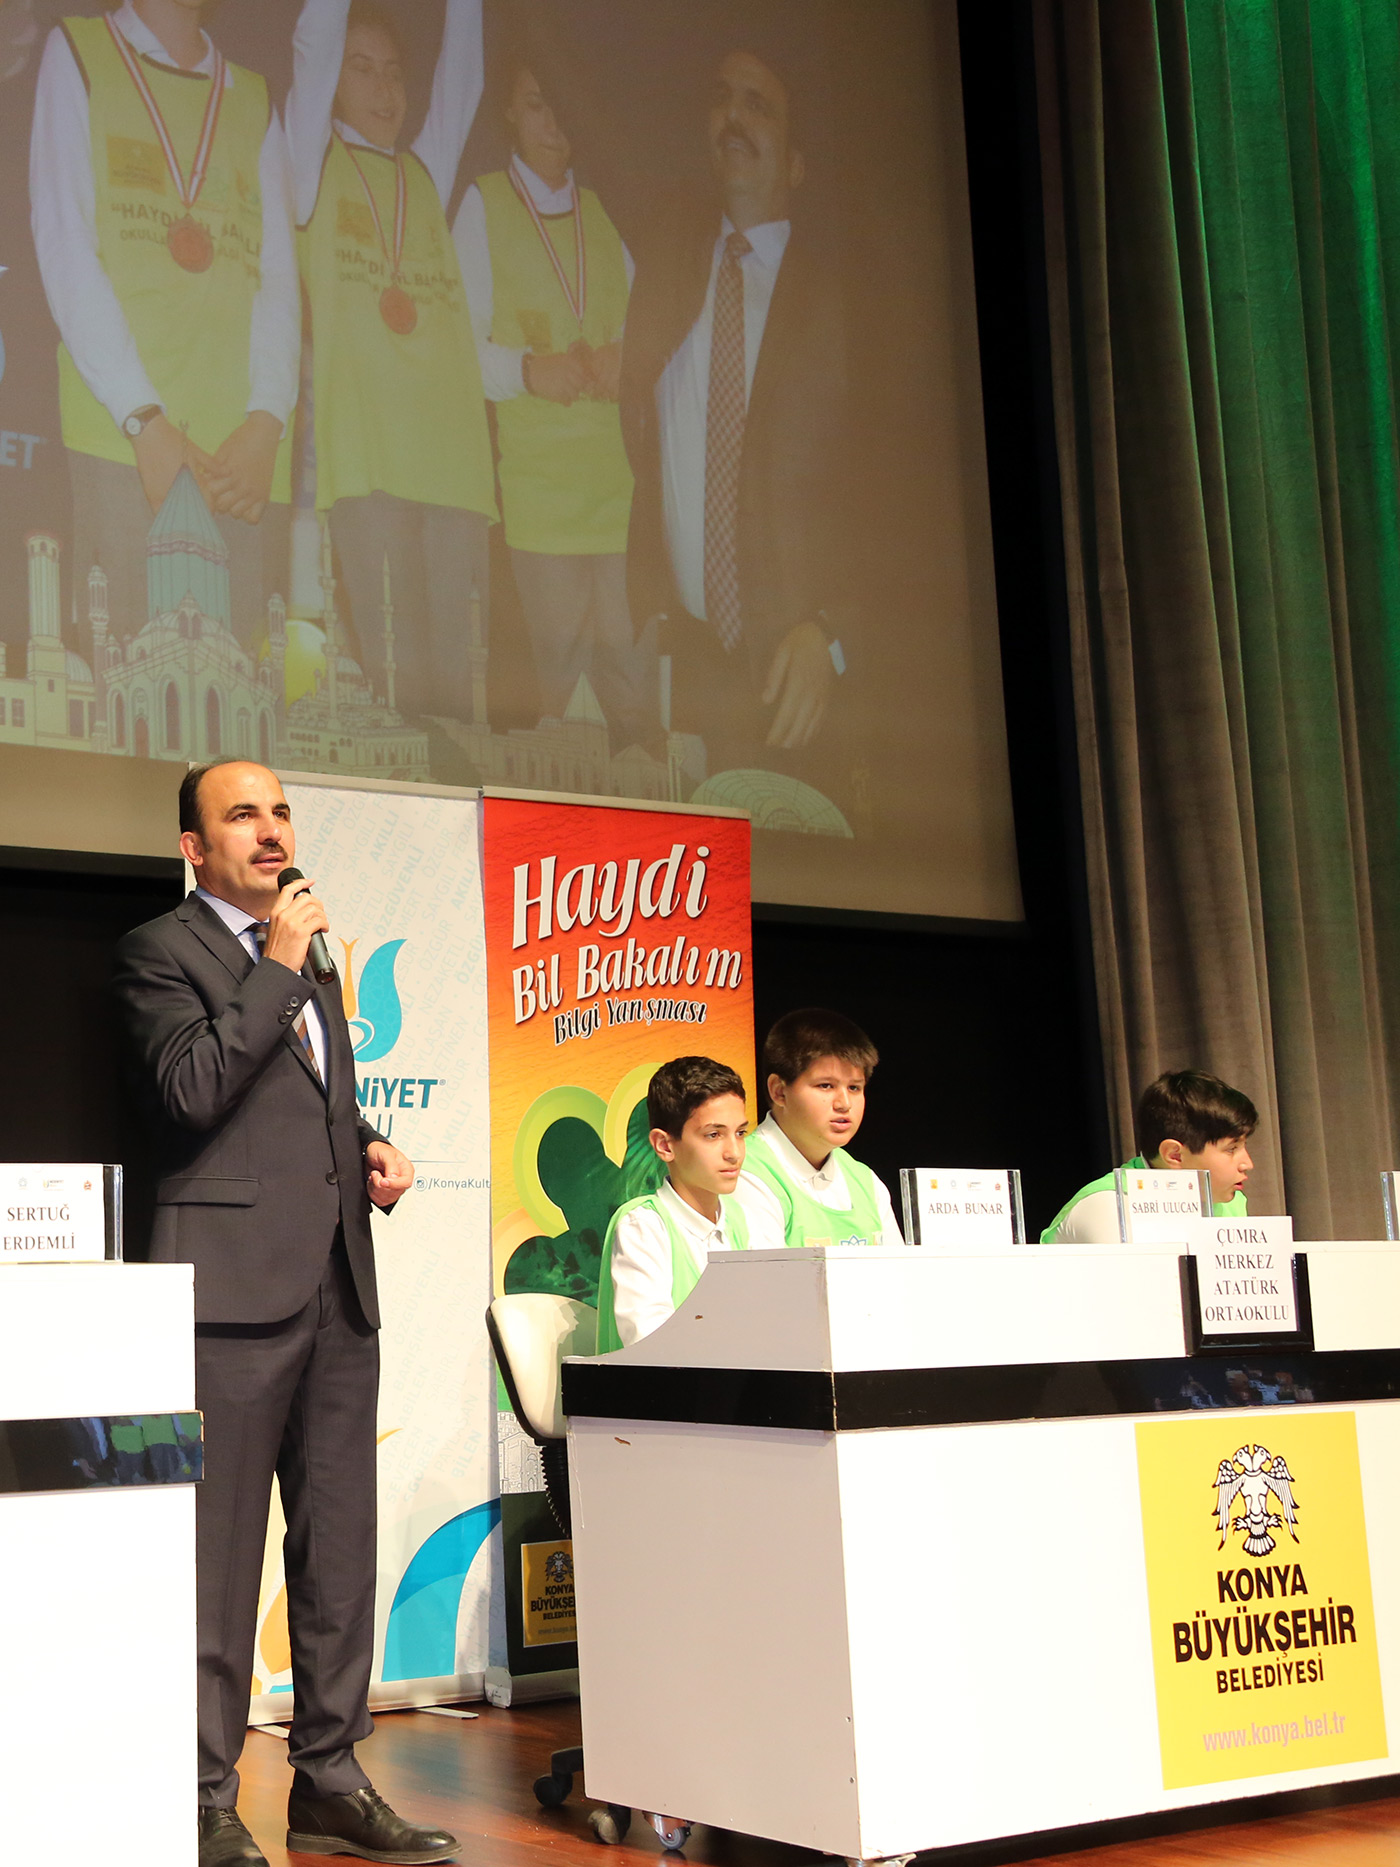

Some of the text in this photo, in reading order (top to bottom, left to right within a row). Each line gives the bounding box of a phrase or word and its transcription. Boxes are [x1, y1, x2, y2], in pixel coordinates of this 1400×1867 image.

[512, 843, 710, 950] Haydi
[512, 953, 563, 1025] Bil
[577, 936, 742, 1000] Bakalım
[553, 997, 707, 1046] Bilgi Yarışması
[7, 1203, 70, 1222] SERTUĞ
[928, 1202, 1004, 1215] ARDA BUNAR
[1132, 1200, 1199, 1214] SABRİ ULUCAN
[3, 1232, 75, 1251] ERDEMLİ
[1217, 1228, 1268, 1247] ÇUMRA
[1215, 1254, 1274, 1270] MERKEZ
[1214, 1276, 1279, 1295] ATATÜRK
[1205, 1305, 1289, 1322] ORTAOKULU
[1216, 1563, 1308, 1603] KONYA
[530, 1595, 576, 1612] BÜYÜKŞE
[543, 1610, 576, 1620] BELEDİYES
[1172, 1597, 1357, 1663] BÜYÜKŞEHİR
[1216, 1652, 1325, 1694] BELEDİYESİ
[1203, 1711, 1346, 1752] www.konya.bel.tr
